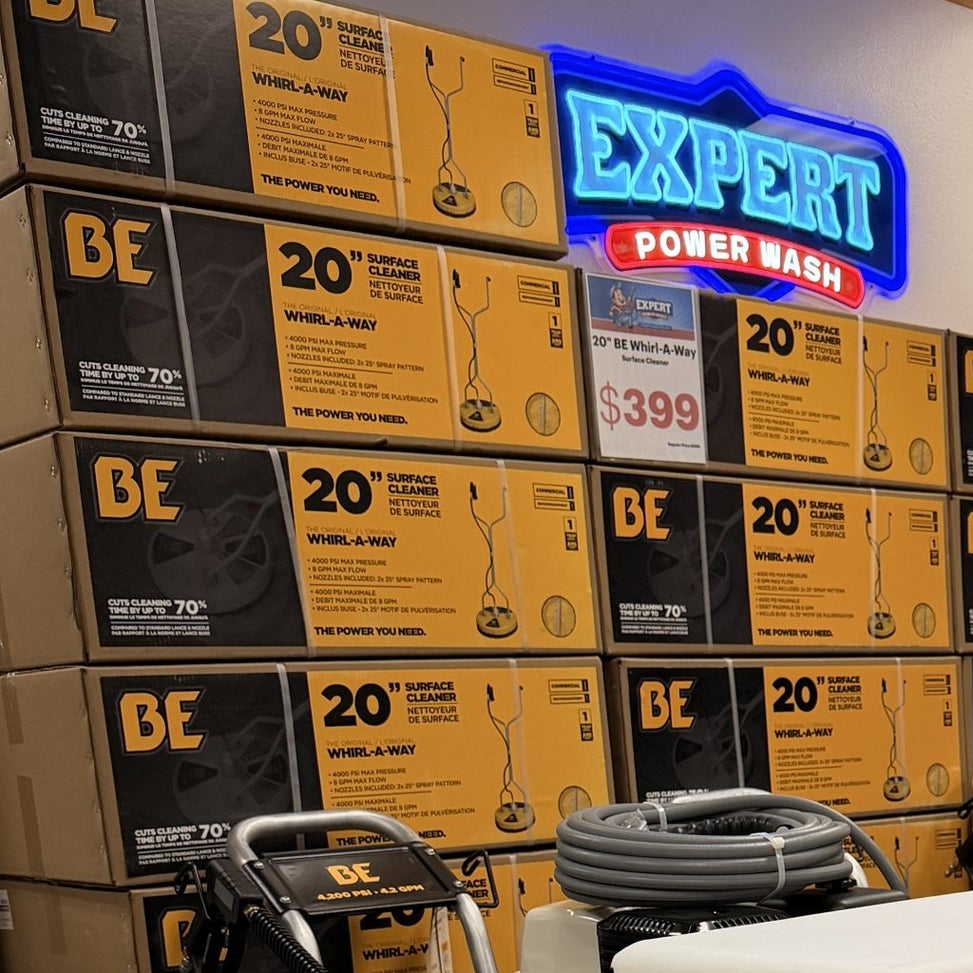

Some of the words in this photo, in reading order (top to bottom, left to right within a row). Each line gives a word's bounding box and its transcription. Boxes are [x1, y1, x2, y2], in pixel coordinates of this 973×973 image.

[338, 21, 387, 40] SURFAC
[252, 72, 349, 103] WHIRL-A-WAY
[111, 119, 148, 142] 70%
[565, 90, 880, 251] EXPERT
[65, 213, 152, 284] BE
[366, 253, 418, 270] SURFACE
[635, 230, 749, 263] POWER
[760, 240, 841, 293] WASH
[368, 265, 420, 281] CLEANER
[368, 279, 420, 294] NETTOYEUR
[369, 289, 381, 298] DE
[383, 291, 423, 304] SURFACE
[636, 299, 672, 314] EXPERT
[284, 309, 378, 331] WHIRL-A-WAY
[805, 322, 840, 336] SURFACE
[288, 335, 307, 343] 4000
[319, 338, 333, 346] MAX
[334, 340, 367, 349] PRESSURE
[806, 332, 841, 346] CLEANER
[592, 335, 612, 347] 20"
[614, 338, 628, 350] BE
[630, 340, 696, 360] Whirl-A-Way
[78, 360, 101, 370] CUTS
[102, 362, 145, 374] CLEANING
[622, 355, 644, 363] Surface
[646, 358, 669, 366] Cleaner
[79, 369, 100, 378] TIME
[101, 371, 113, 379] BY
[114, 372, 126, 380] UP
[127, 373, 140, 381] TO
[147, 367, 183, 385] 70%
[748, 369, 811, 387] WHIRL-A-WAY
[600, 381, 699, 431] $399
[292, 406, 314, 416] THE
[315, 408, 354, 420] POWER
[355, 411, 377, 422] YOU
[378, 413, 408, 424] NEED.
[387, 473, 437, 485] SURFACE
[94, 457, 179, 520] BE
[388, 484, 439, 496] CLEANER
[613, 487, 669, 539] BE
[809, 501, 844, 511] SURFACE
[810, 510, 845, 520] CLEANER
[307, 533, 398, 548] WHIRL-A-WAY
[754, 551, 816, 563] WHIRL-A-WAY
[174, 599, 208, 615] 70%
[405, 682, 455, 692] SURFACE
[828, 676, 860, 684] SURFACE
[828, 685, 862, 693] CLEANER
[406, 692, 457, 702] CLEANER
[640, 681, 692, 729] BE
[120, 691, 202, 751] BE
[775, 728, 834, 738] WHIRL-A-WAY
[327, 745, 417, 759] WHIRL-A-WAY
[326, 862, 380, 885] BE
[352, 889, 372, 897] PSI
[398, 885, 424, 893] GPM
[363, 944, 428, 961] WHIRL-A-
